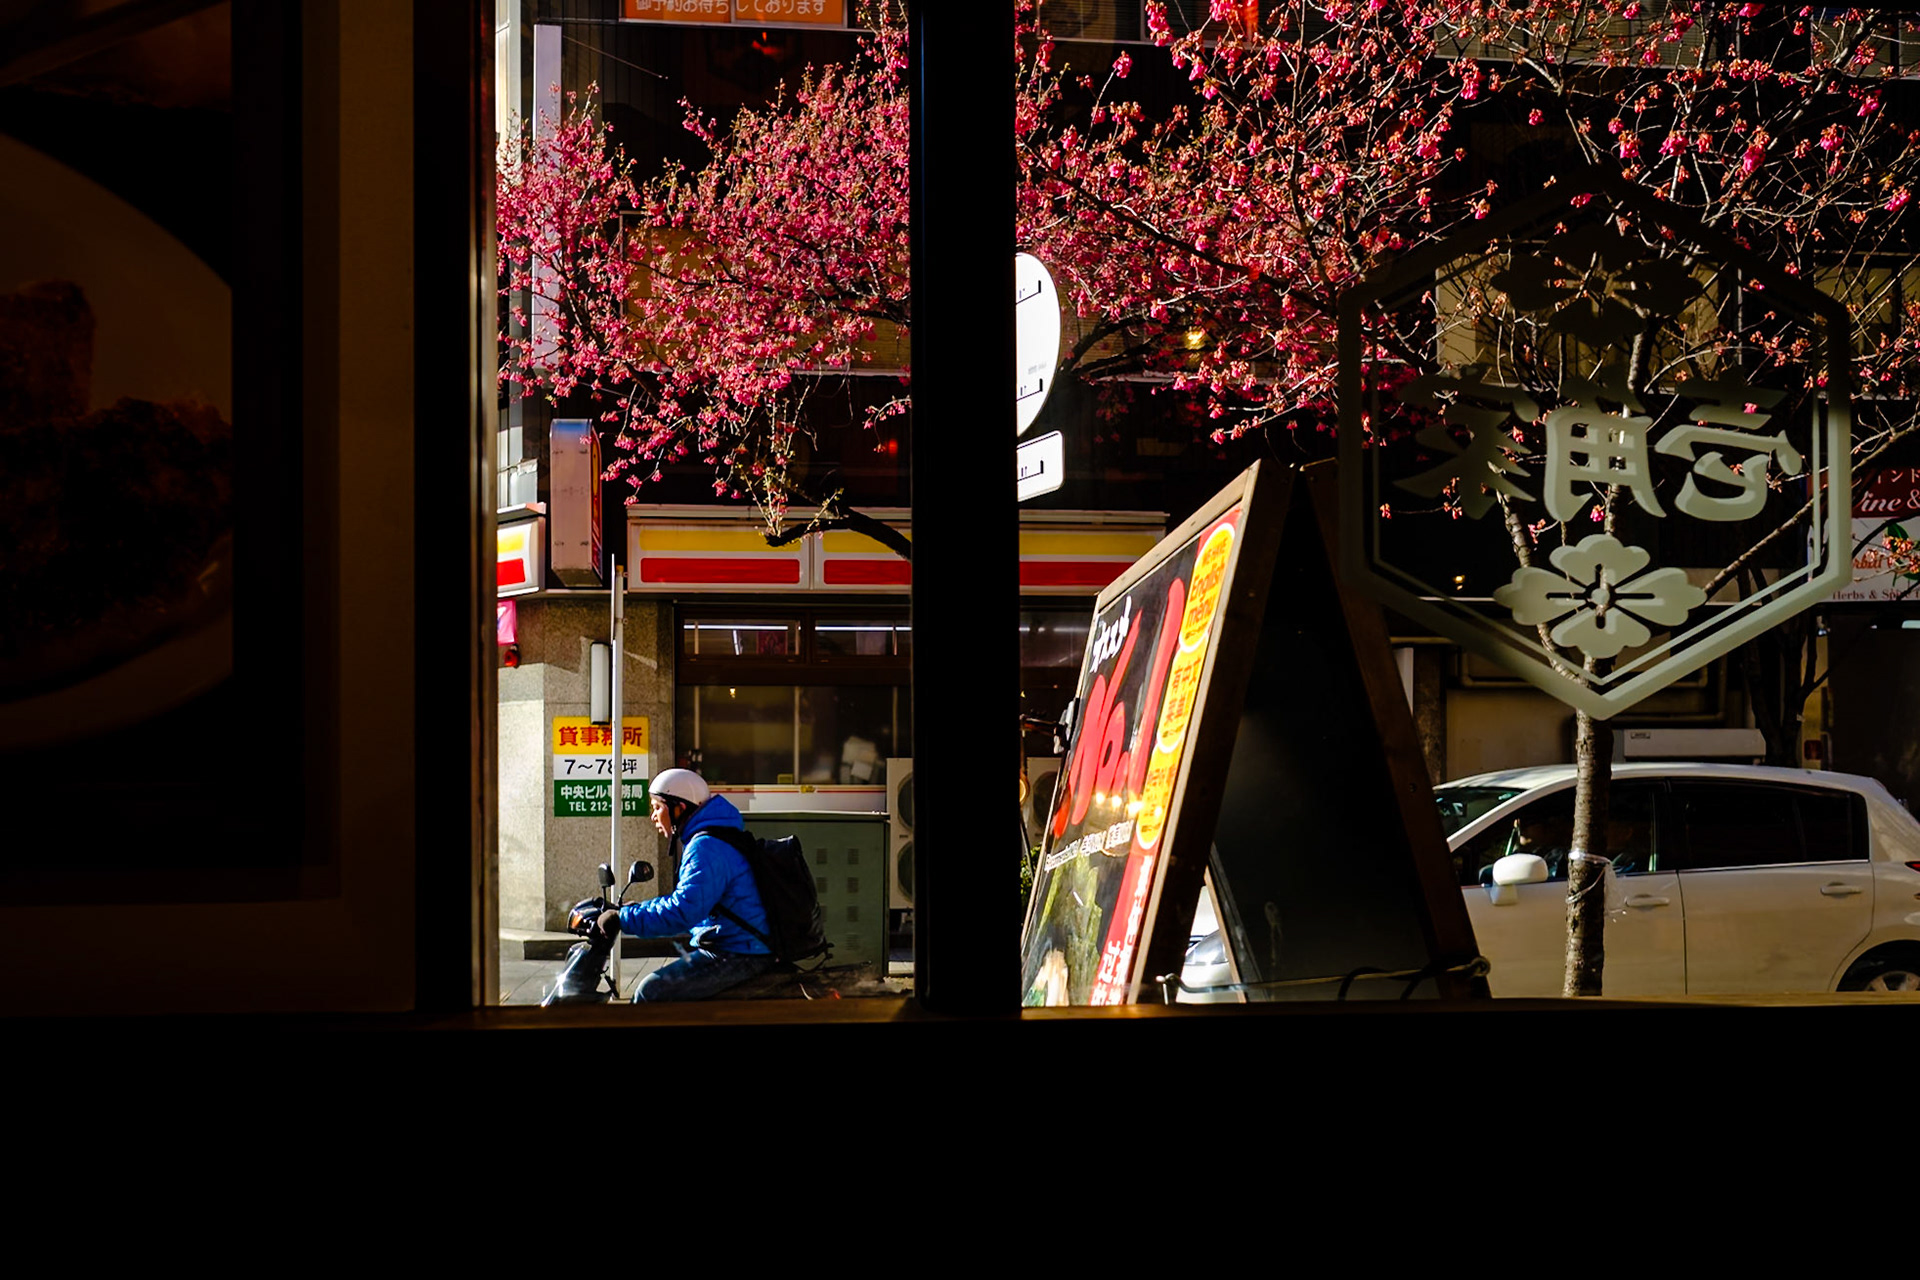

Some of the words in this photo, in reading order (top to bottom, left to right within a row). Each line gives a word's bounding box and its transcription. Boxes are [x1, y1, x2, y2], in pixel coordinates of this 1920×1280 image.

[1190, 557, 1225, 602] English
[1186, 595, 1216, 630] menu
[569, 801, 587, 812] TEL
